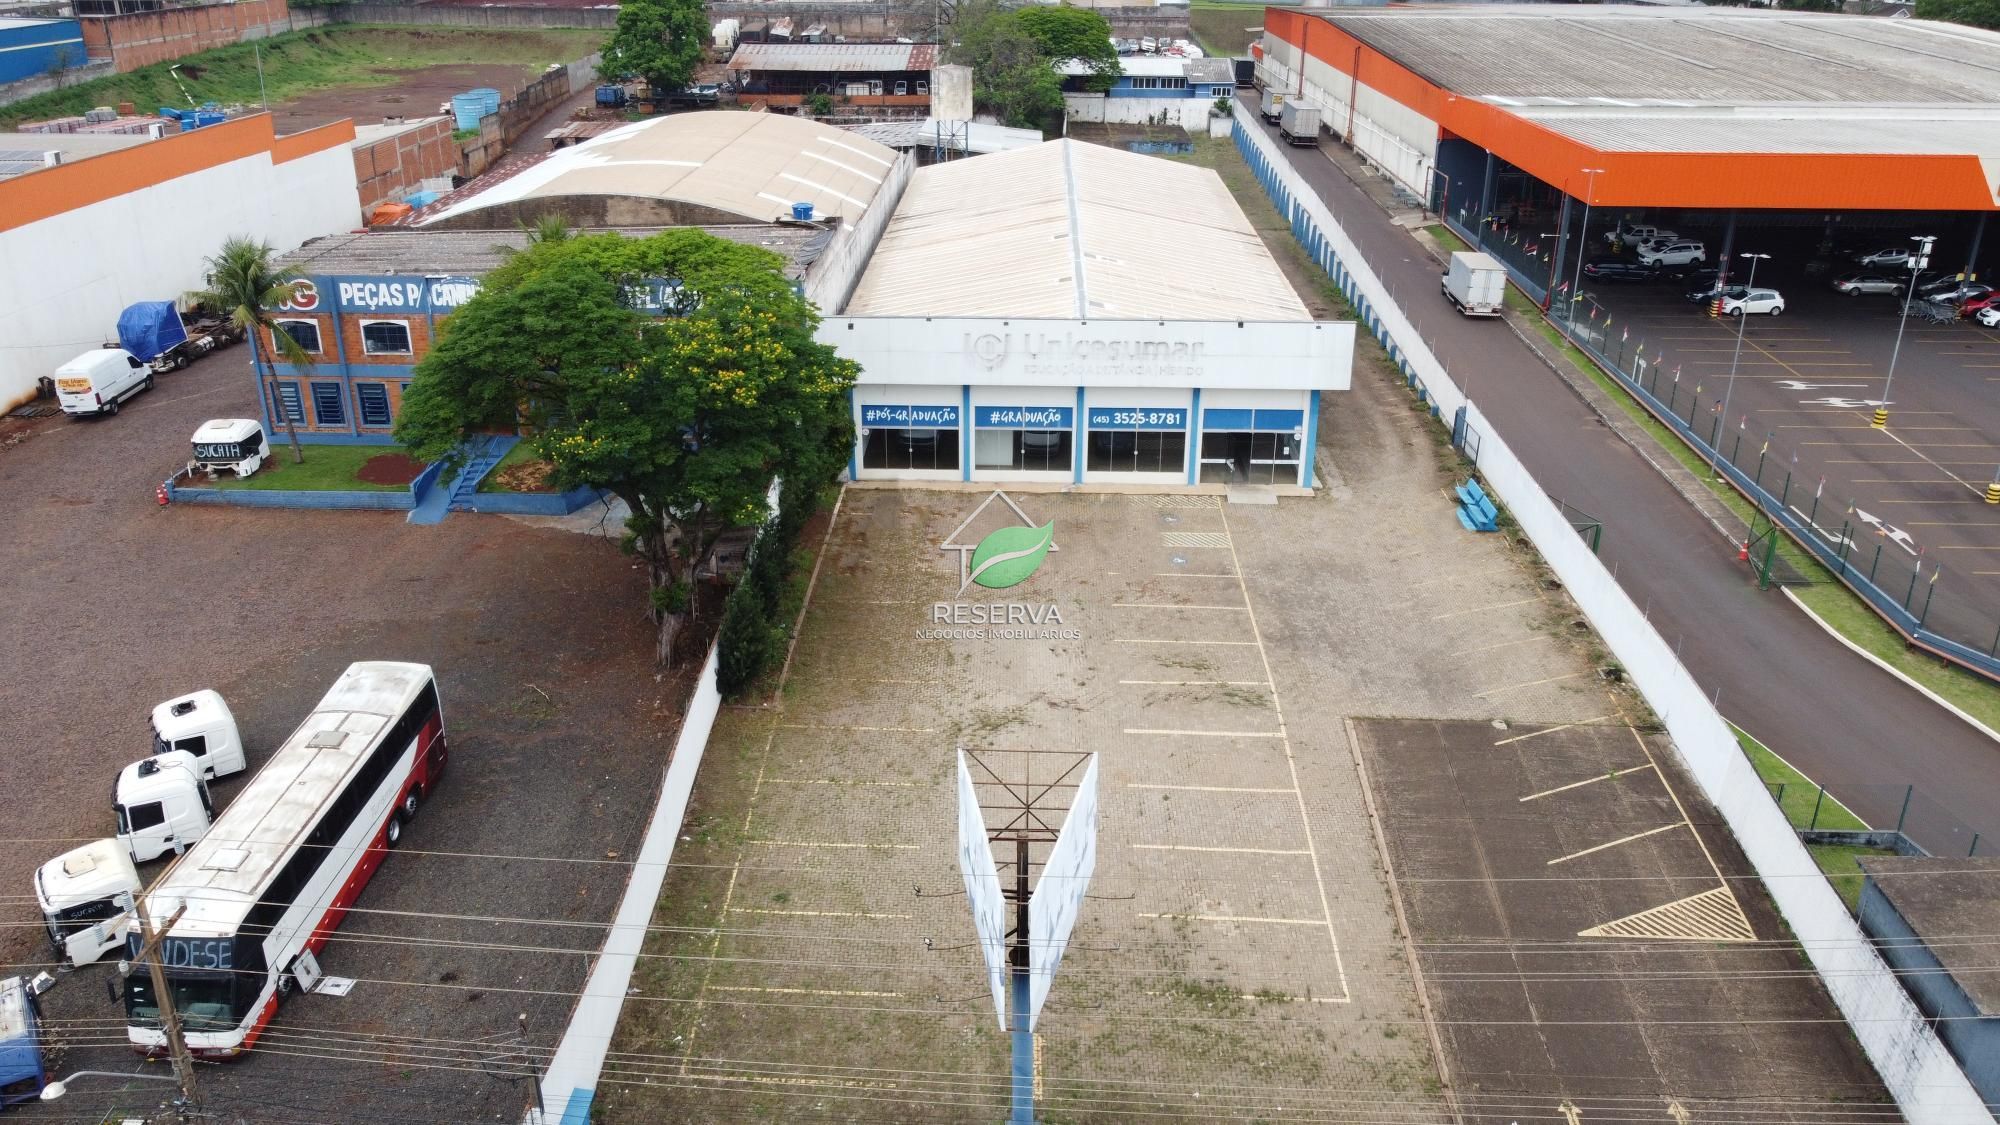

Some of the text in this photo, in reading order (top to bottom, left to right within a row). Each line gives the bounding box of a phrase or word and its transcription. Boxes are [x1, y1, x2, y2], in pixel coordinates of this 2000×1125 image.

[339, 283, 402, 310] PEÇAS
[406, 283, 423, 308] P/
[866, 408, 956, 424] #PÓS-GRADUAÇÃO
[990, 408, 1061, 425] #GRADUAÇÃO
[1093, 415, 1110, 424] (45)
[197, 443, 240, 458] SUCATA
